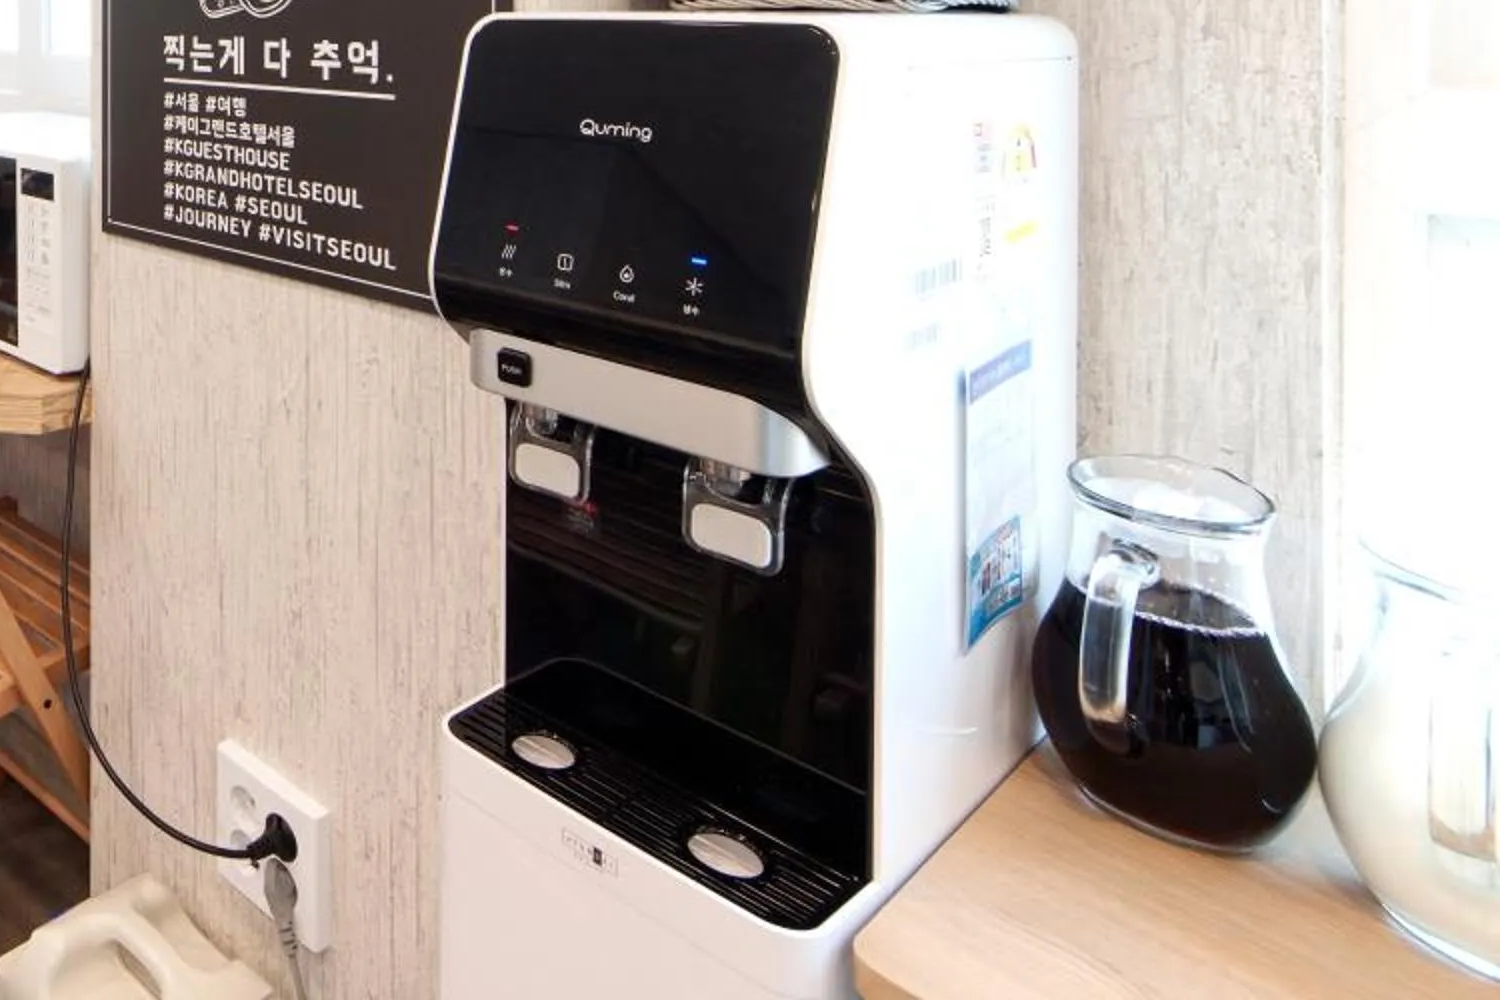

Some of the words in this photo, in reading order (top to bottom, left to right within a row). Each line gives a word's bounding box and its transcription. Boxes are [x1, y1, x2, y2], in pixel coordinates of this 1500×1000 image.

[163, 34, 245, 76] 찍는게
[263, 37, 291, 79] 다
[310, 38, 394, 85] 추억.
[163, 91, 200, 113] #서울
[205, 95, 248, 118] #여행
[163, 136, 291, 172] #KGUESTHOUSE
[163, 159, 364, 210] #KGRANDHOTELSEOUL
[163, 181, 229, 210] #KOREA
[234, 194, 309, 226] #SEOUL
[163, 203, 252, 238] #JOURNEY
[258, 222, 398, 271] #VISITSEOUL
